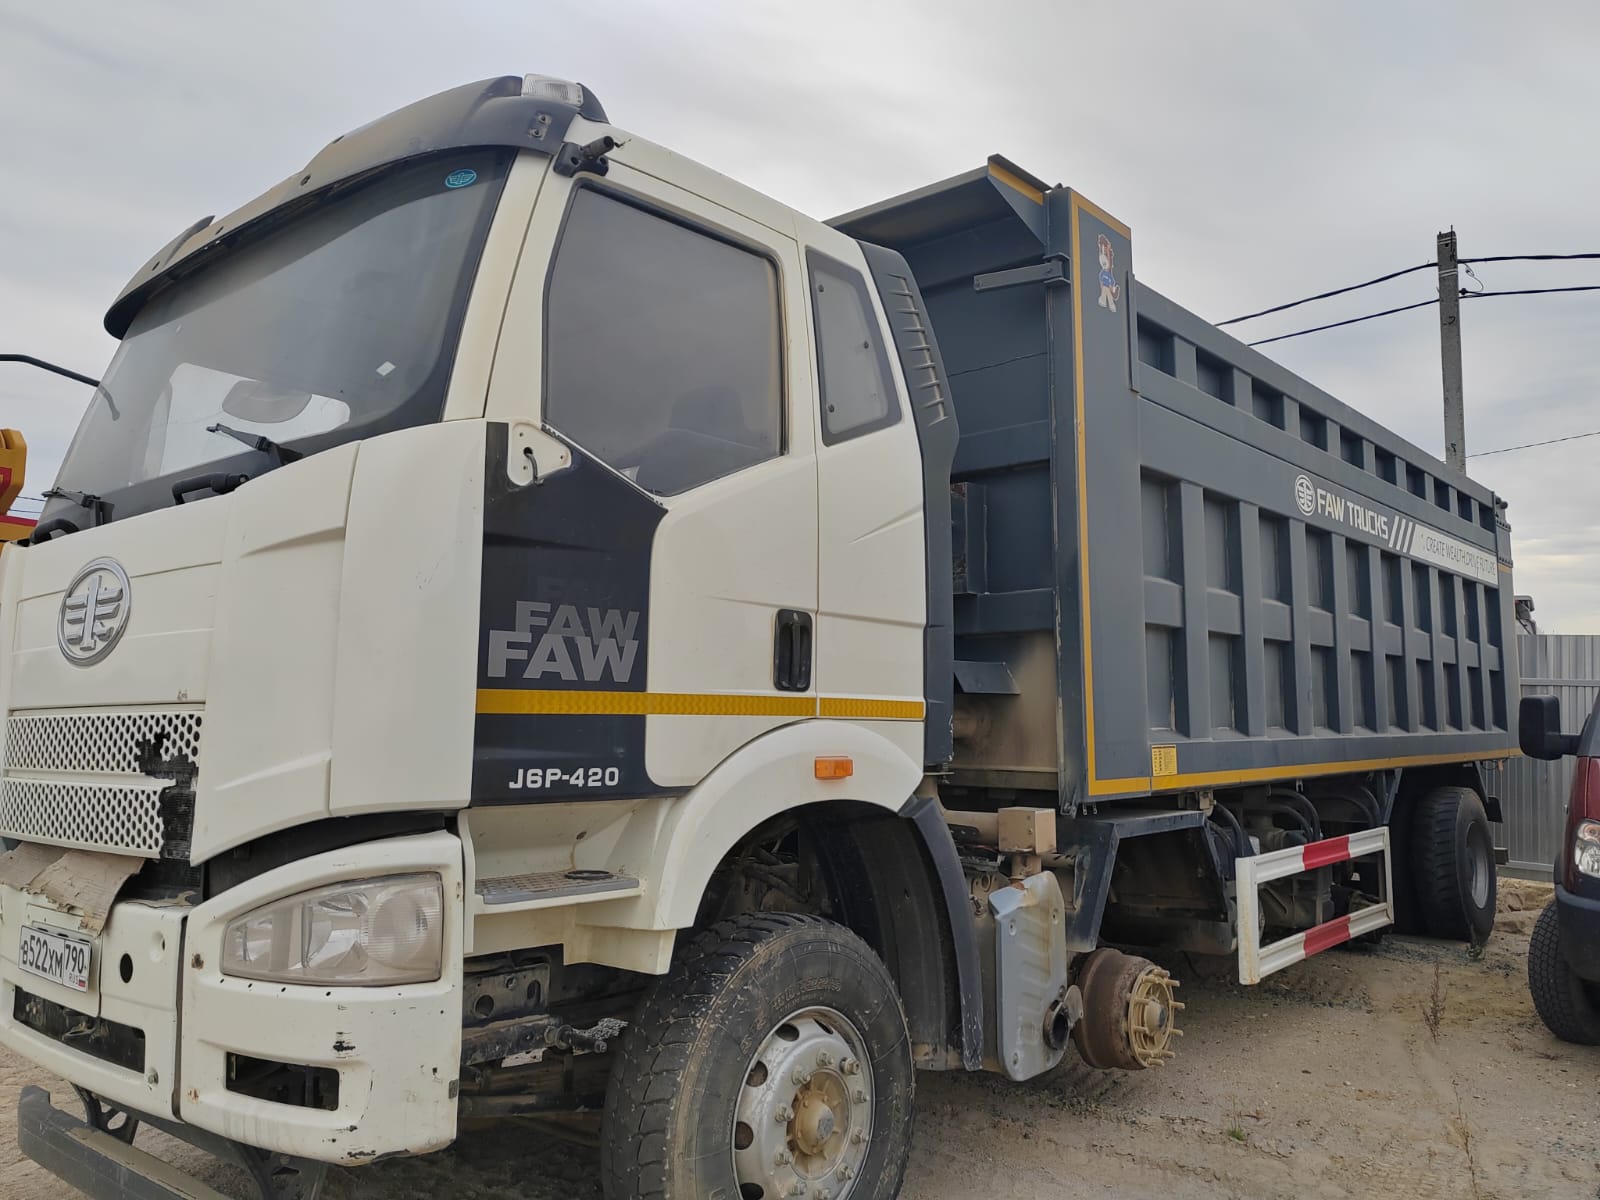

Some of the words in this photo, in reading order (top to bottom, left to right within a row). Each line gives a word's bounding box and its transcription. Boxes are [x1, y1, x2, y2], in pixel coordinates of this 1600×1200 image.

[1316, 488, 1345, 522] FAW
[1347, 501, 1388, 540] TRUCKS
[1426, 536, 1445, 558] CREATE
[515, 600, 640, 648] FAW
[487, 629, 639, 683] FAW
[508, 767, 620, 789] J6P-420
[65, 944, 85, 974] 790
